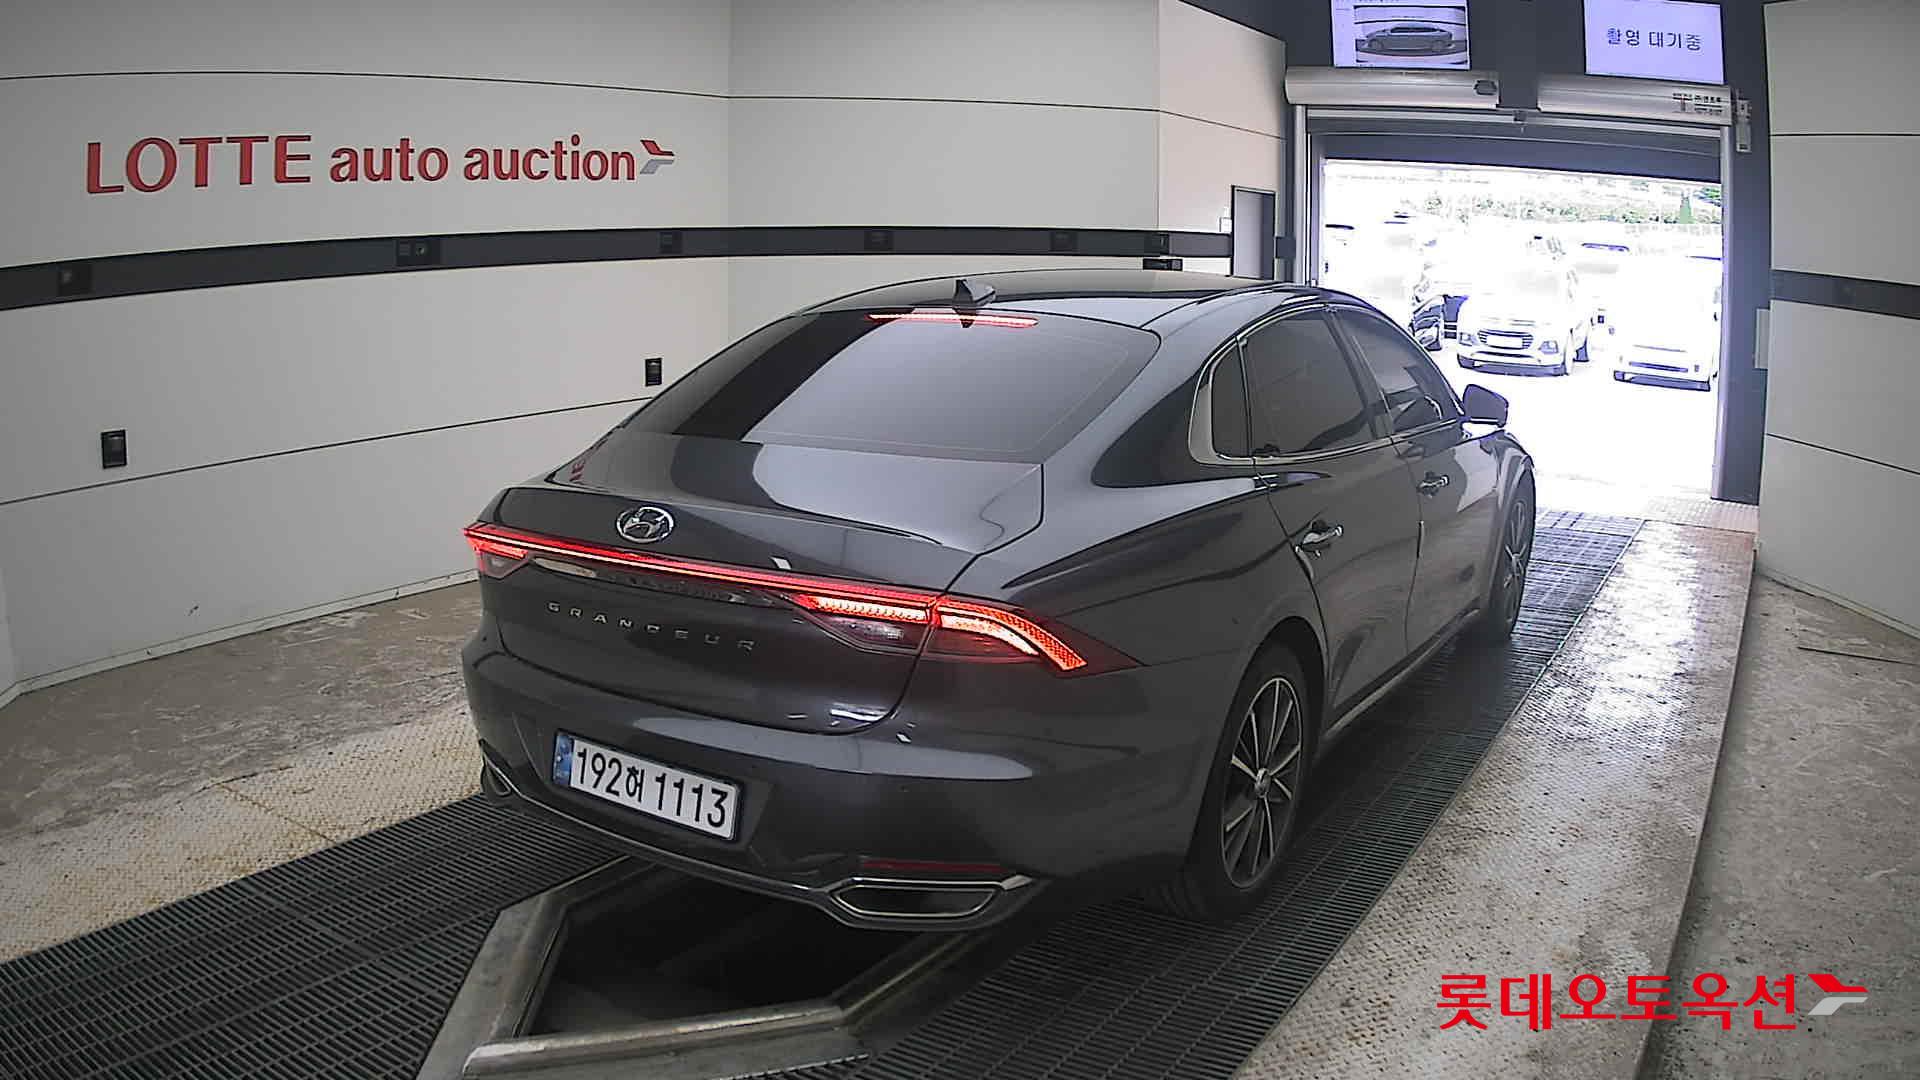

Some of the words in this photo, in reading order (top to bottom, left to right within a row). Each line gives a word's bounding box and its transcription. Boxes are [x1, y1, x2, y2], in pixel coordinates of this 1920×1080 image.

[1607, 27, 1640, 47] 촬영
[1648, 31, 1702, 52] 대기중
[87, 135, 311, 194] LOTTE
[329, 137, 449, 182] auto
[463, 134, 636, 181] auction
[548, 602, 755, 651] GRANDEUR
[577, 748, 645, 803] 192허
[655, 772, 728, 828] 1113
